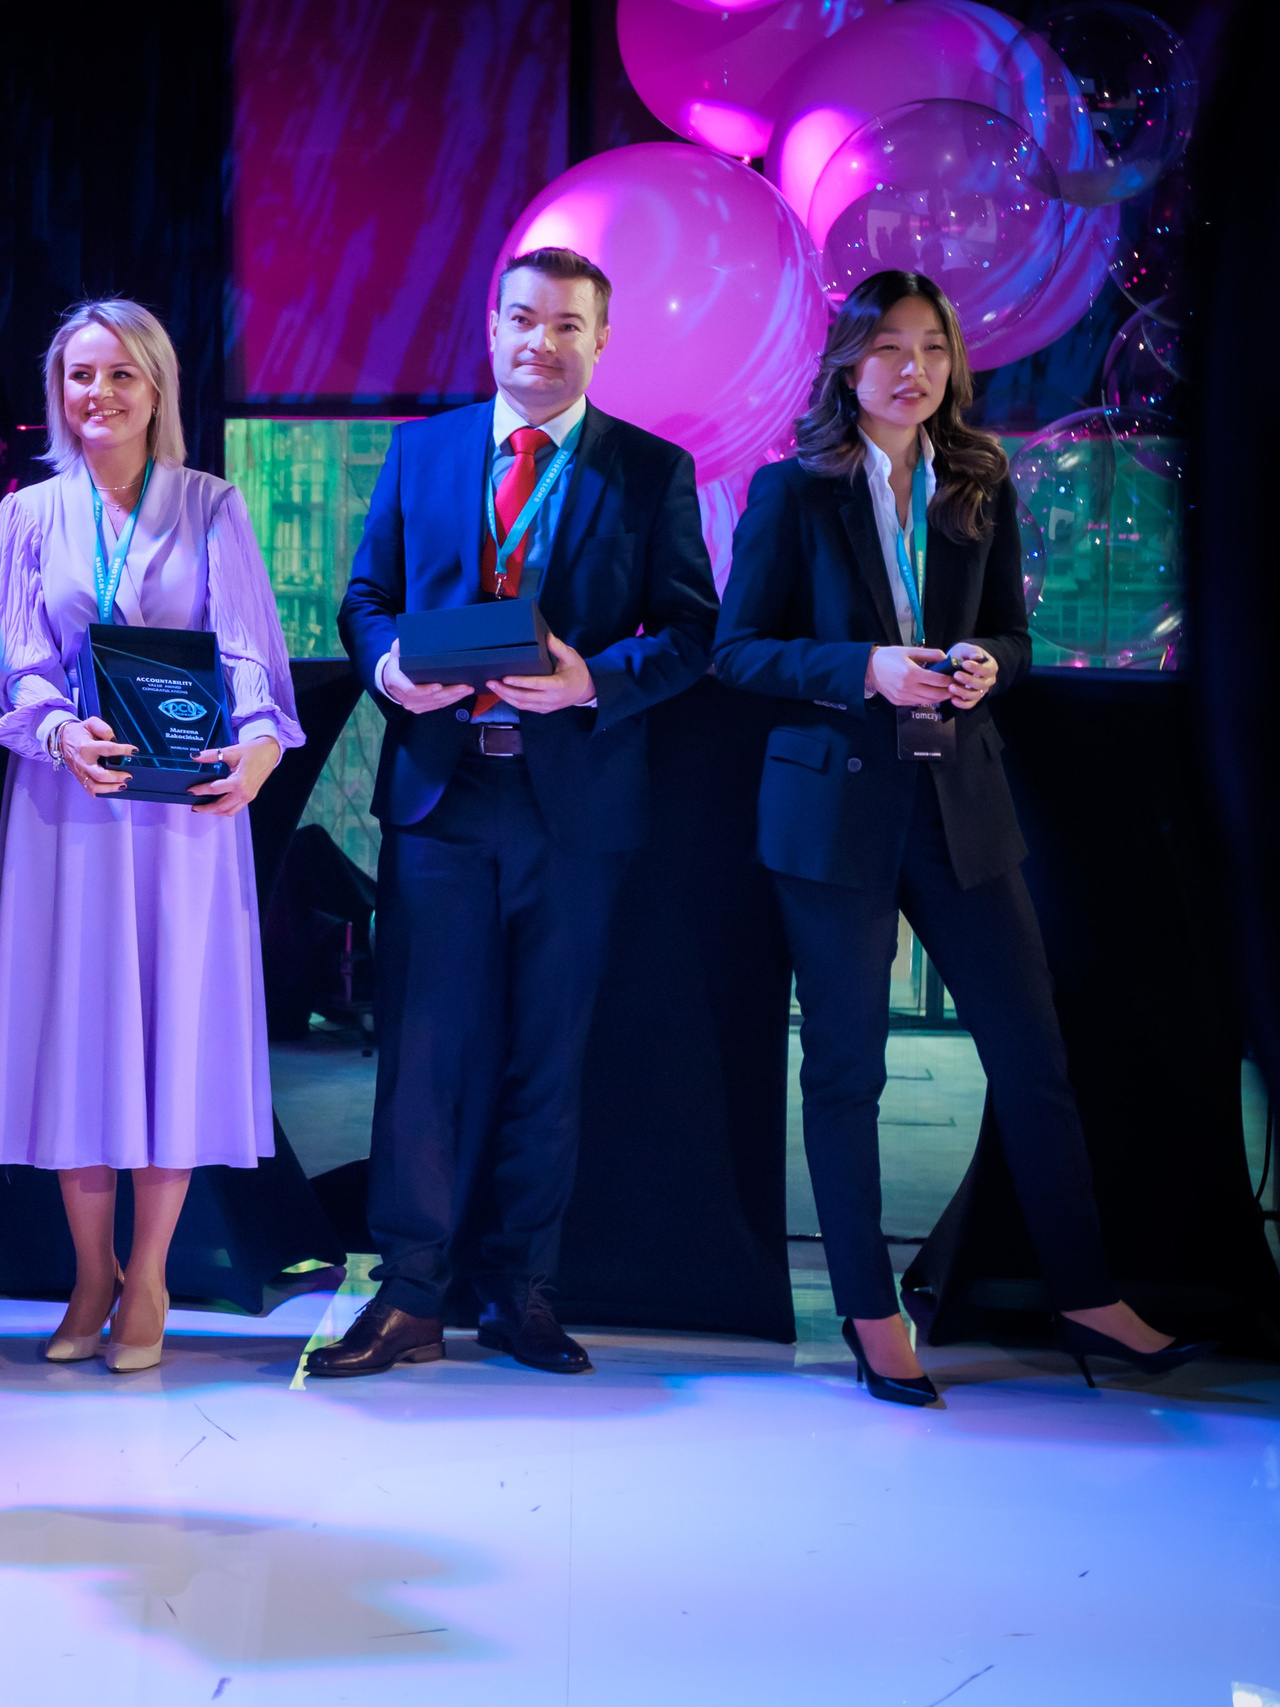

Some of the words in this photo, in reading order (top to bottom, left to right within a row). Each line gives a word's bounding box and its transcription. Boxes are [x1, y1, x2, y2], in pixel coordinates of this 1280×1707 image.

[534, 483, 548, 502] LOMB
[95, 556, 105, 590] BAUSCH
[103, 584, 114, 618] BAUSCH
[110, 557, 122, 579] LOMB
[136, 676, 193, 687] ACCOUNTABILITY
[911, 710, 943, 722] Tomczyk
[169, 727, 199, 735] Marzena
